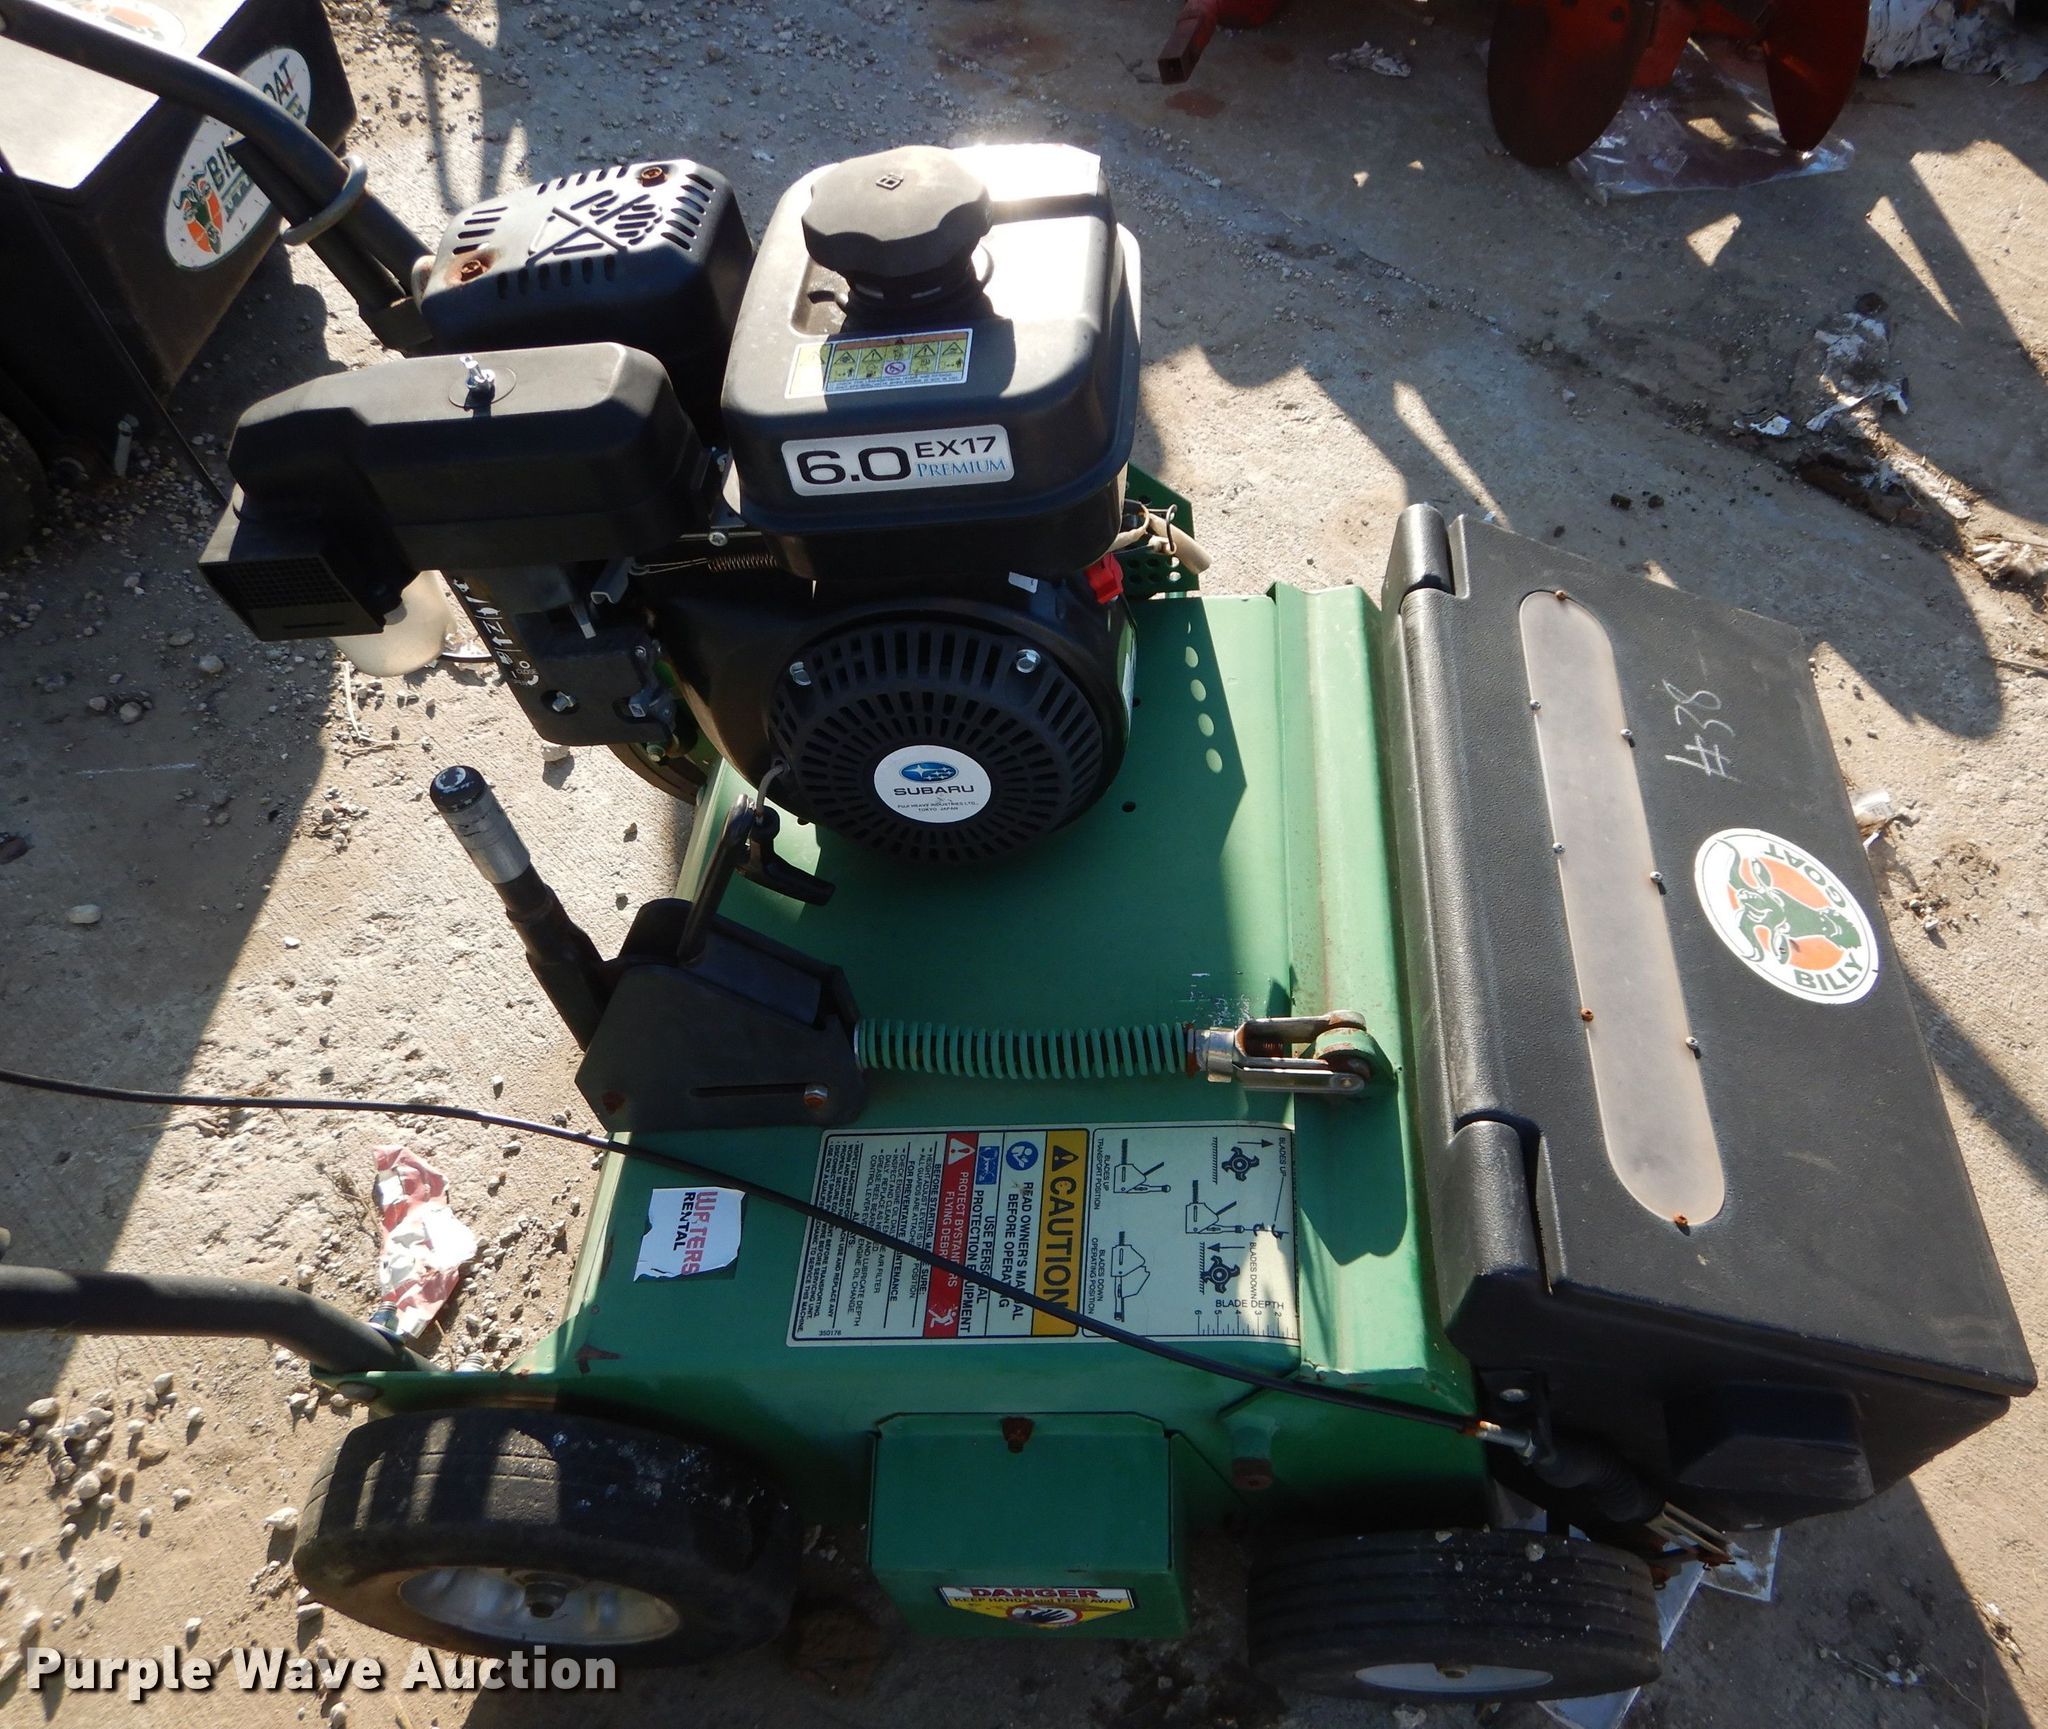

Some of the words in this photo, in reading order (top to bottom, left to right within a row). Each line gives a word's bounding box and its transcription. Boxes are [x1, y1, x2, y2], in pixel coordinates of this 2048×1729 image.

[797, 446, 911, 485] 6.0
[915, 436, 996, 458] EX17
[917, 460, 1007, 478] PREMIUM
[894, 785, 974, 796] SUBARU
[1764, 843, 1846, 909] GOAT
[1794, 953, 1863, 991] BILLY
[1095, 1138, 1104, 1176] TRANSPORT
[1279, 1137, 1287, 1165] BLADES
[866, 1155, 878, 1187] CONTROL
[874, 1154, 885, 1182] GREASE
[889, 1154, 899, 1183] INSPECT
[898, 1154, 907, 1179] CHECK
[906, 1161, 915, 1177] FOR
[925, 1154, 933, 1179] HEIGHT
[931, 1163, 941, 1195] BEFORE
[1103, 1155, 1111, 1181] BLADES
[1280, 1166, 1287, 1177] UP
[873, 1183, 881, 1202] REEL
[879, 1177, 889, 1208] REPLACE
[894, 1180, 903, 1205] ENGINE
[914, 1168, 924, 1196] GUARDS
[921, 1180, 930, 1206] ADJUST
[955, 1172, 969, 1216] PROTECT
[1094, 1178, 1102, 1210] POSITION
[1103, 1182, 1110, 1192] UP
[862, 1188, 872, 1211] LEVER
[898, 1178, 912, 1238] PREVENTATIVE
[942, 1191, 955, 1225] FLYING
[1021, 1182, 1034, 1212] READ
[673, 1192, 696, 1251] RENTAL
[877, 1210, 884, 1220] AS
[884, 1200, 893, 1224] CLEAN
[917, 1208, 926, 1231] LEVER
[967, 1190, 984, 1261] PROTECTION
[1005, 1193, 1019, 1238] BEFORE
[983, 1216, 995, 1238] USE
[1017, 1215, 1031, 1267] OWNER'S
[854, 1238, 865, 1266] ENGINE
[1043, 1177, 1077, 1308] CAUTION
[1089, 1237, 1099, 1278] OPERATING
[1097, 1249, 1106, 1277] BLADES
[852, 1268, 861, 1280] OIL
[858, 1258, 869, 1298] LUBRICATE
[874, 1268, 884, 1294] FILTER
[909, 1263, 920, 1299] POSITION
[919, 1269, 929, 1295] SURE:
[960, 1264, 976, 1333] EUIPMENT
[1012, 1270, 1026, 1321] MAAL
[1088, 1280, 1096, 1314] POSITION
[1097, 1278, 1105, 1301] DOWN
[854, 1300, 864, 1327] DEPTH
[1216, 1300, 1248, 1308] BLADE
[1250, 1300, 1284, 1310] DEPTH
[969, 1587, 1102, 1598] DANGER
